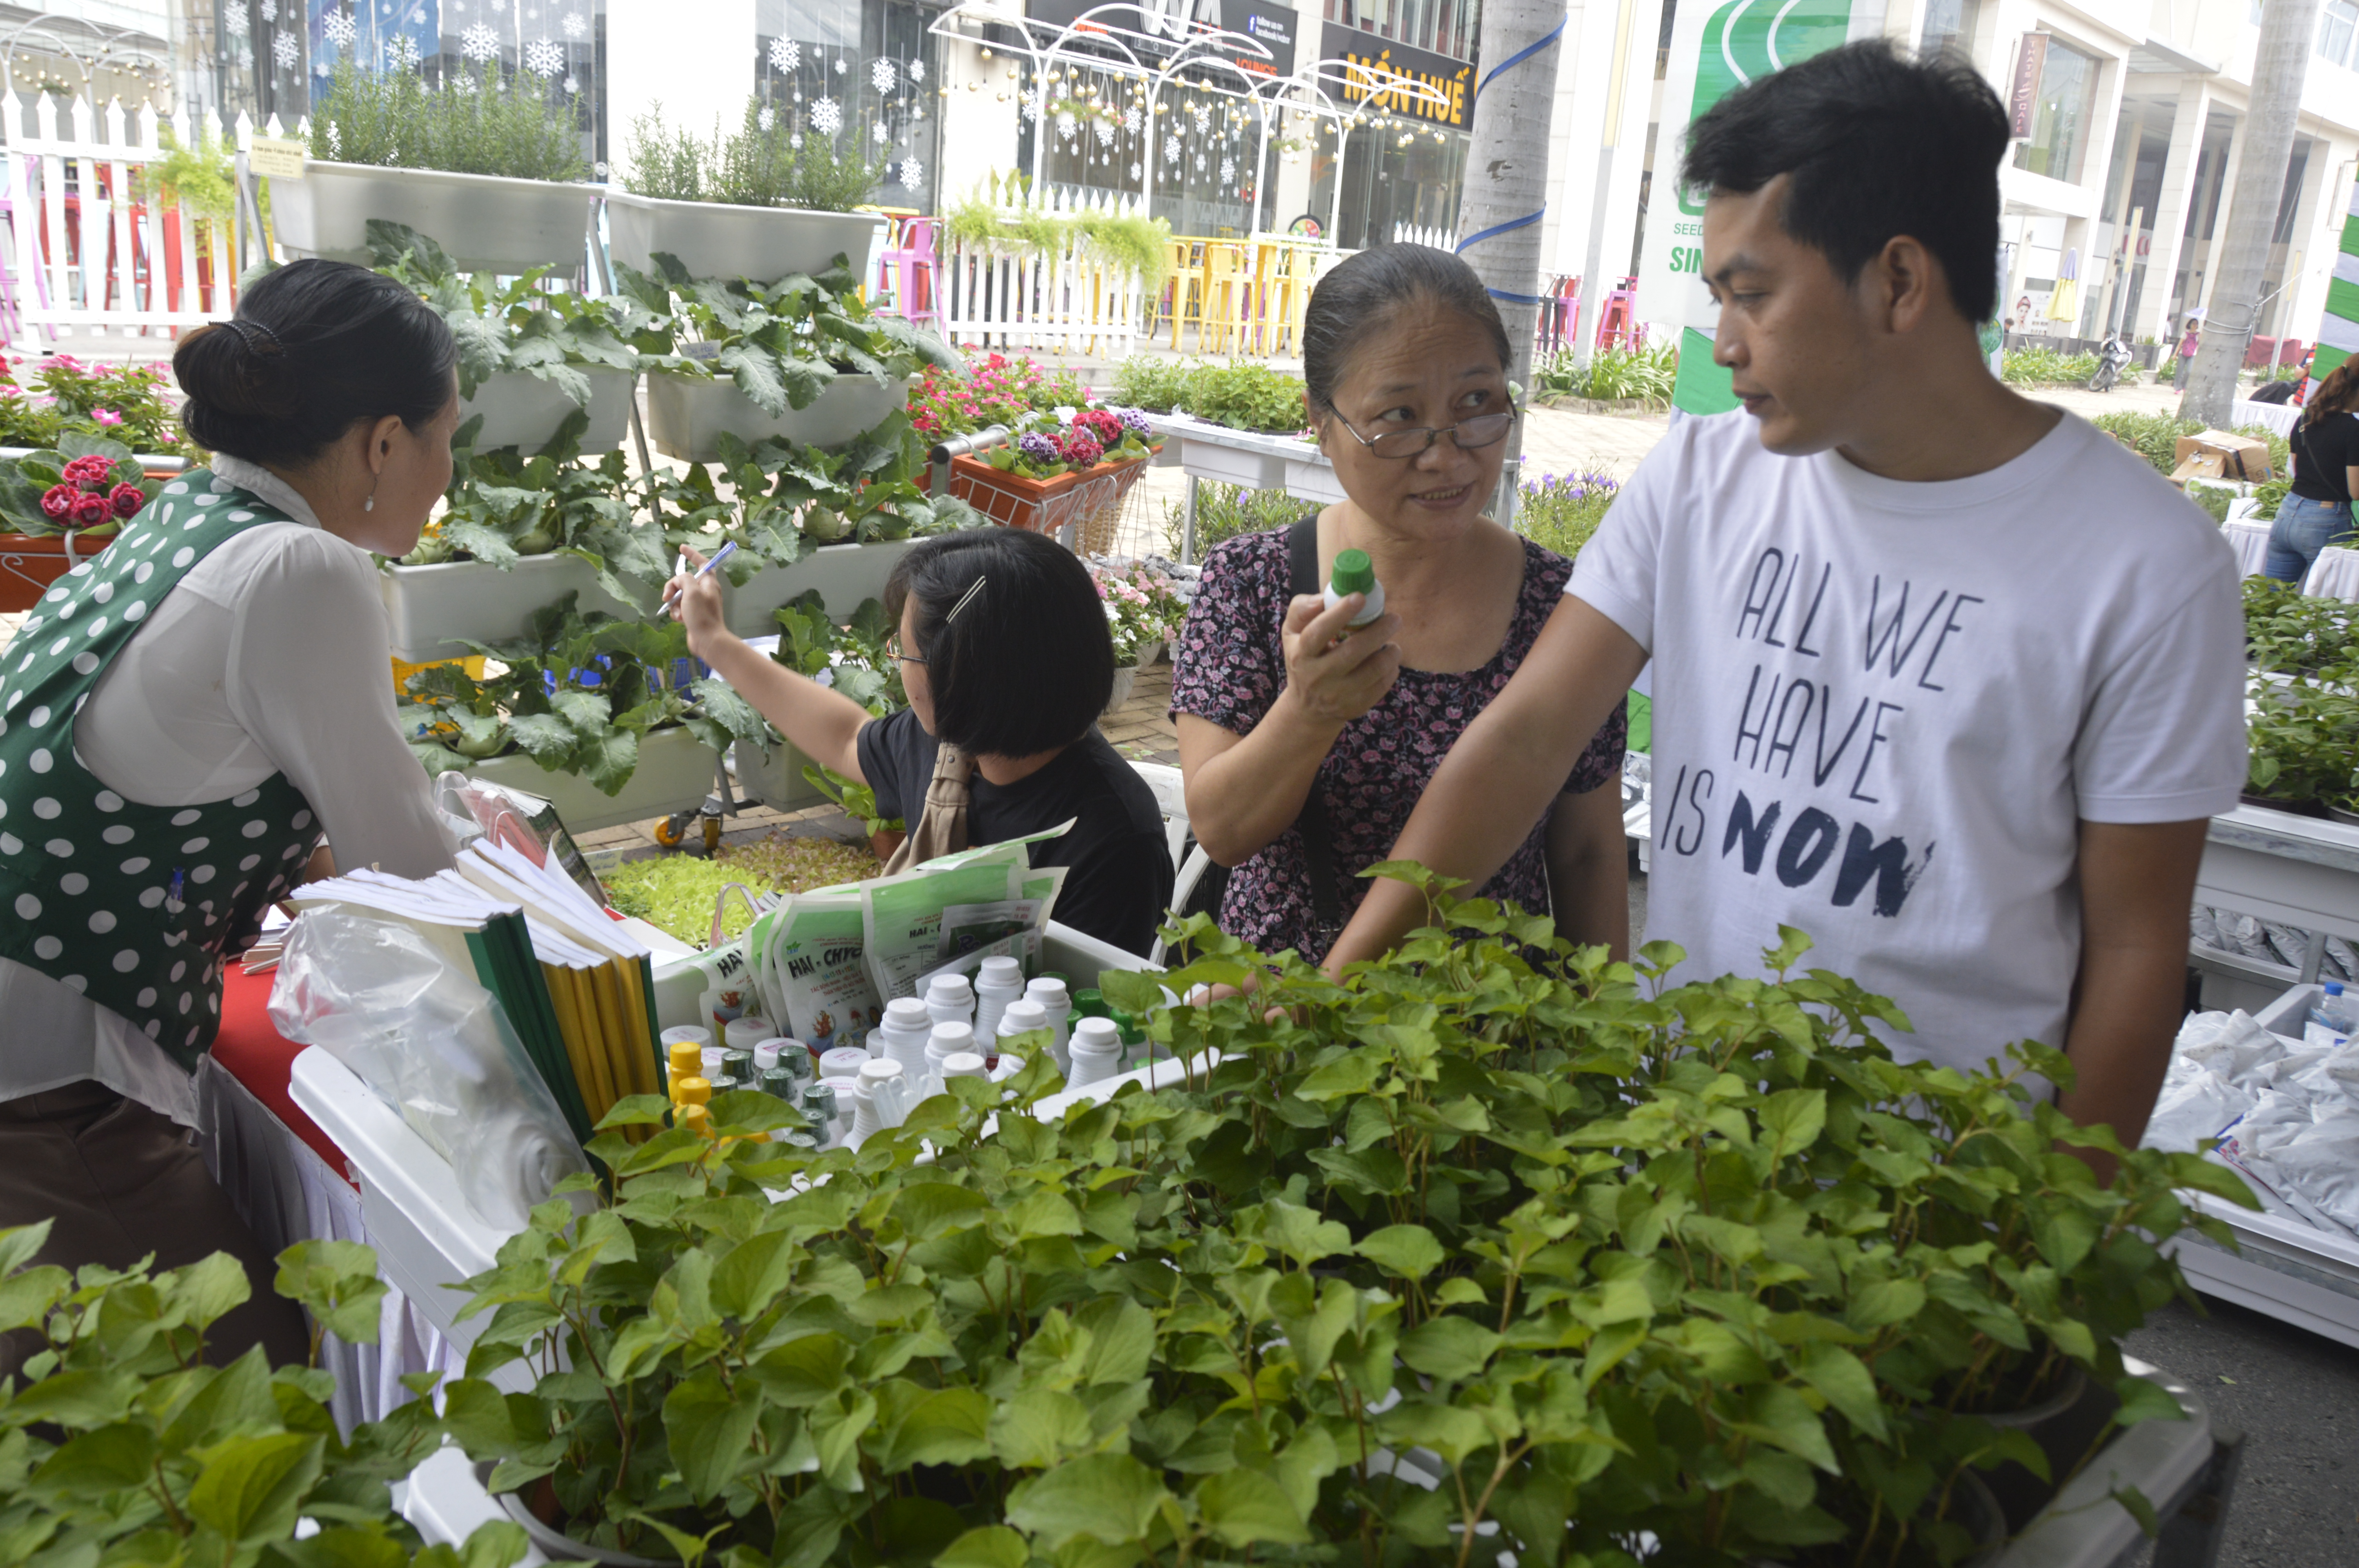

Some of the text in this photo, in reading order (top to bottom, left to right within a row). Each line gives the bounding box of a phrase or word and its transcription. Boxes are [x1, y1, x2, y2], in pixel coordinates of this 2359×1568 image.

[1256, 15, 1283, 31] follow us on
[1344, 49, 1412, 113] MÓN
[1416, 67, 1470, 124] HUẾ
[1737, 546, 1985, 692] ALL WE
[1733, 664, 1904, 804] HAVE
[1661, 764, 1936, 918] IS NOW
[788, 955, 816, 980] HAI
[909, 927, 927, 938] HAI
